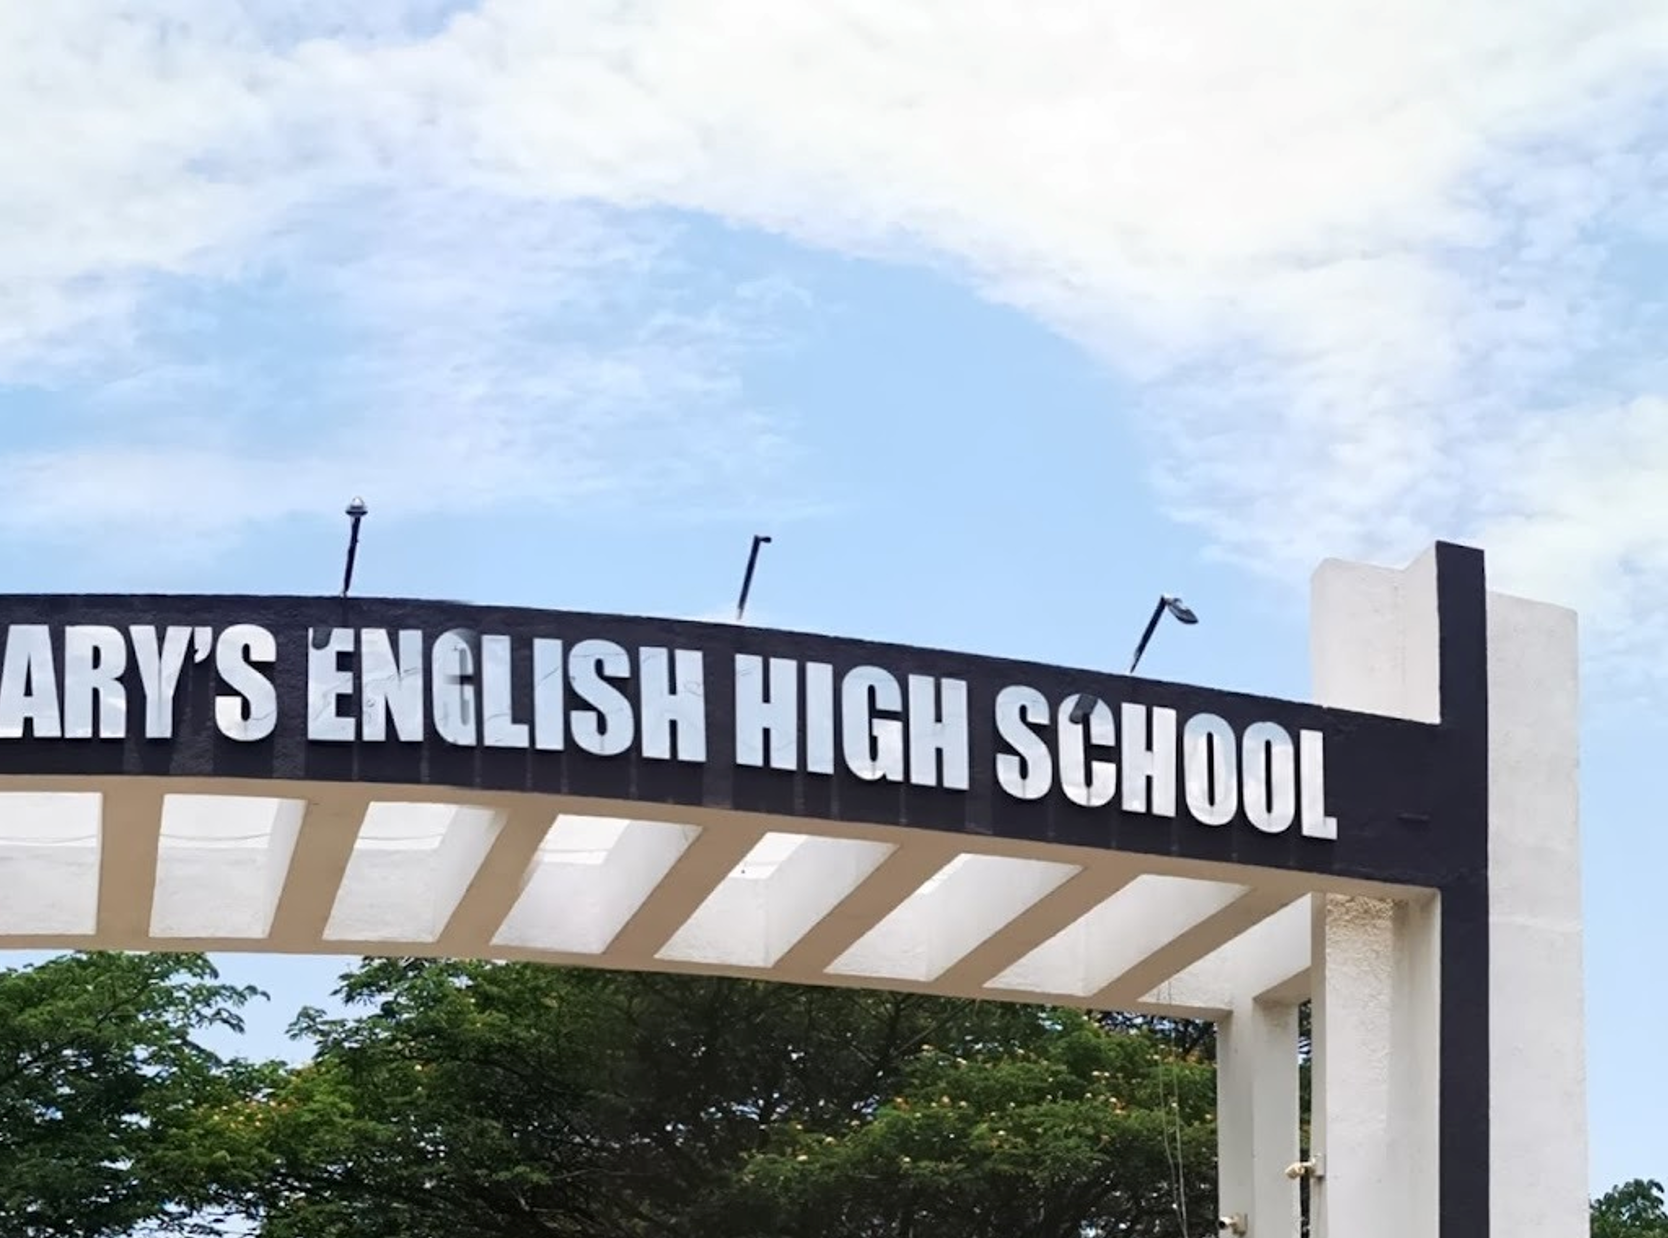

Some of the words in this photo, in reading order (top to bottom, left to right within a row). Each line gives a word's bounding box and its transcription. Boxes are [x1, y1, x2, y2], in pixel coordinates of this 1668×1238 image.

[306, 626, 707, 764] ENGLISH
[734, 652, 971, 791] HIGH
[995, 684, 1338, 841] SCHOOL
